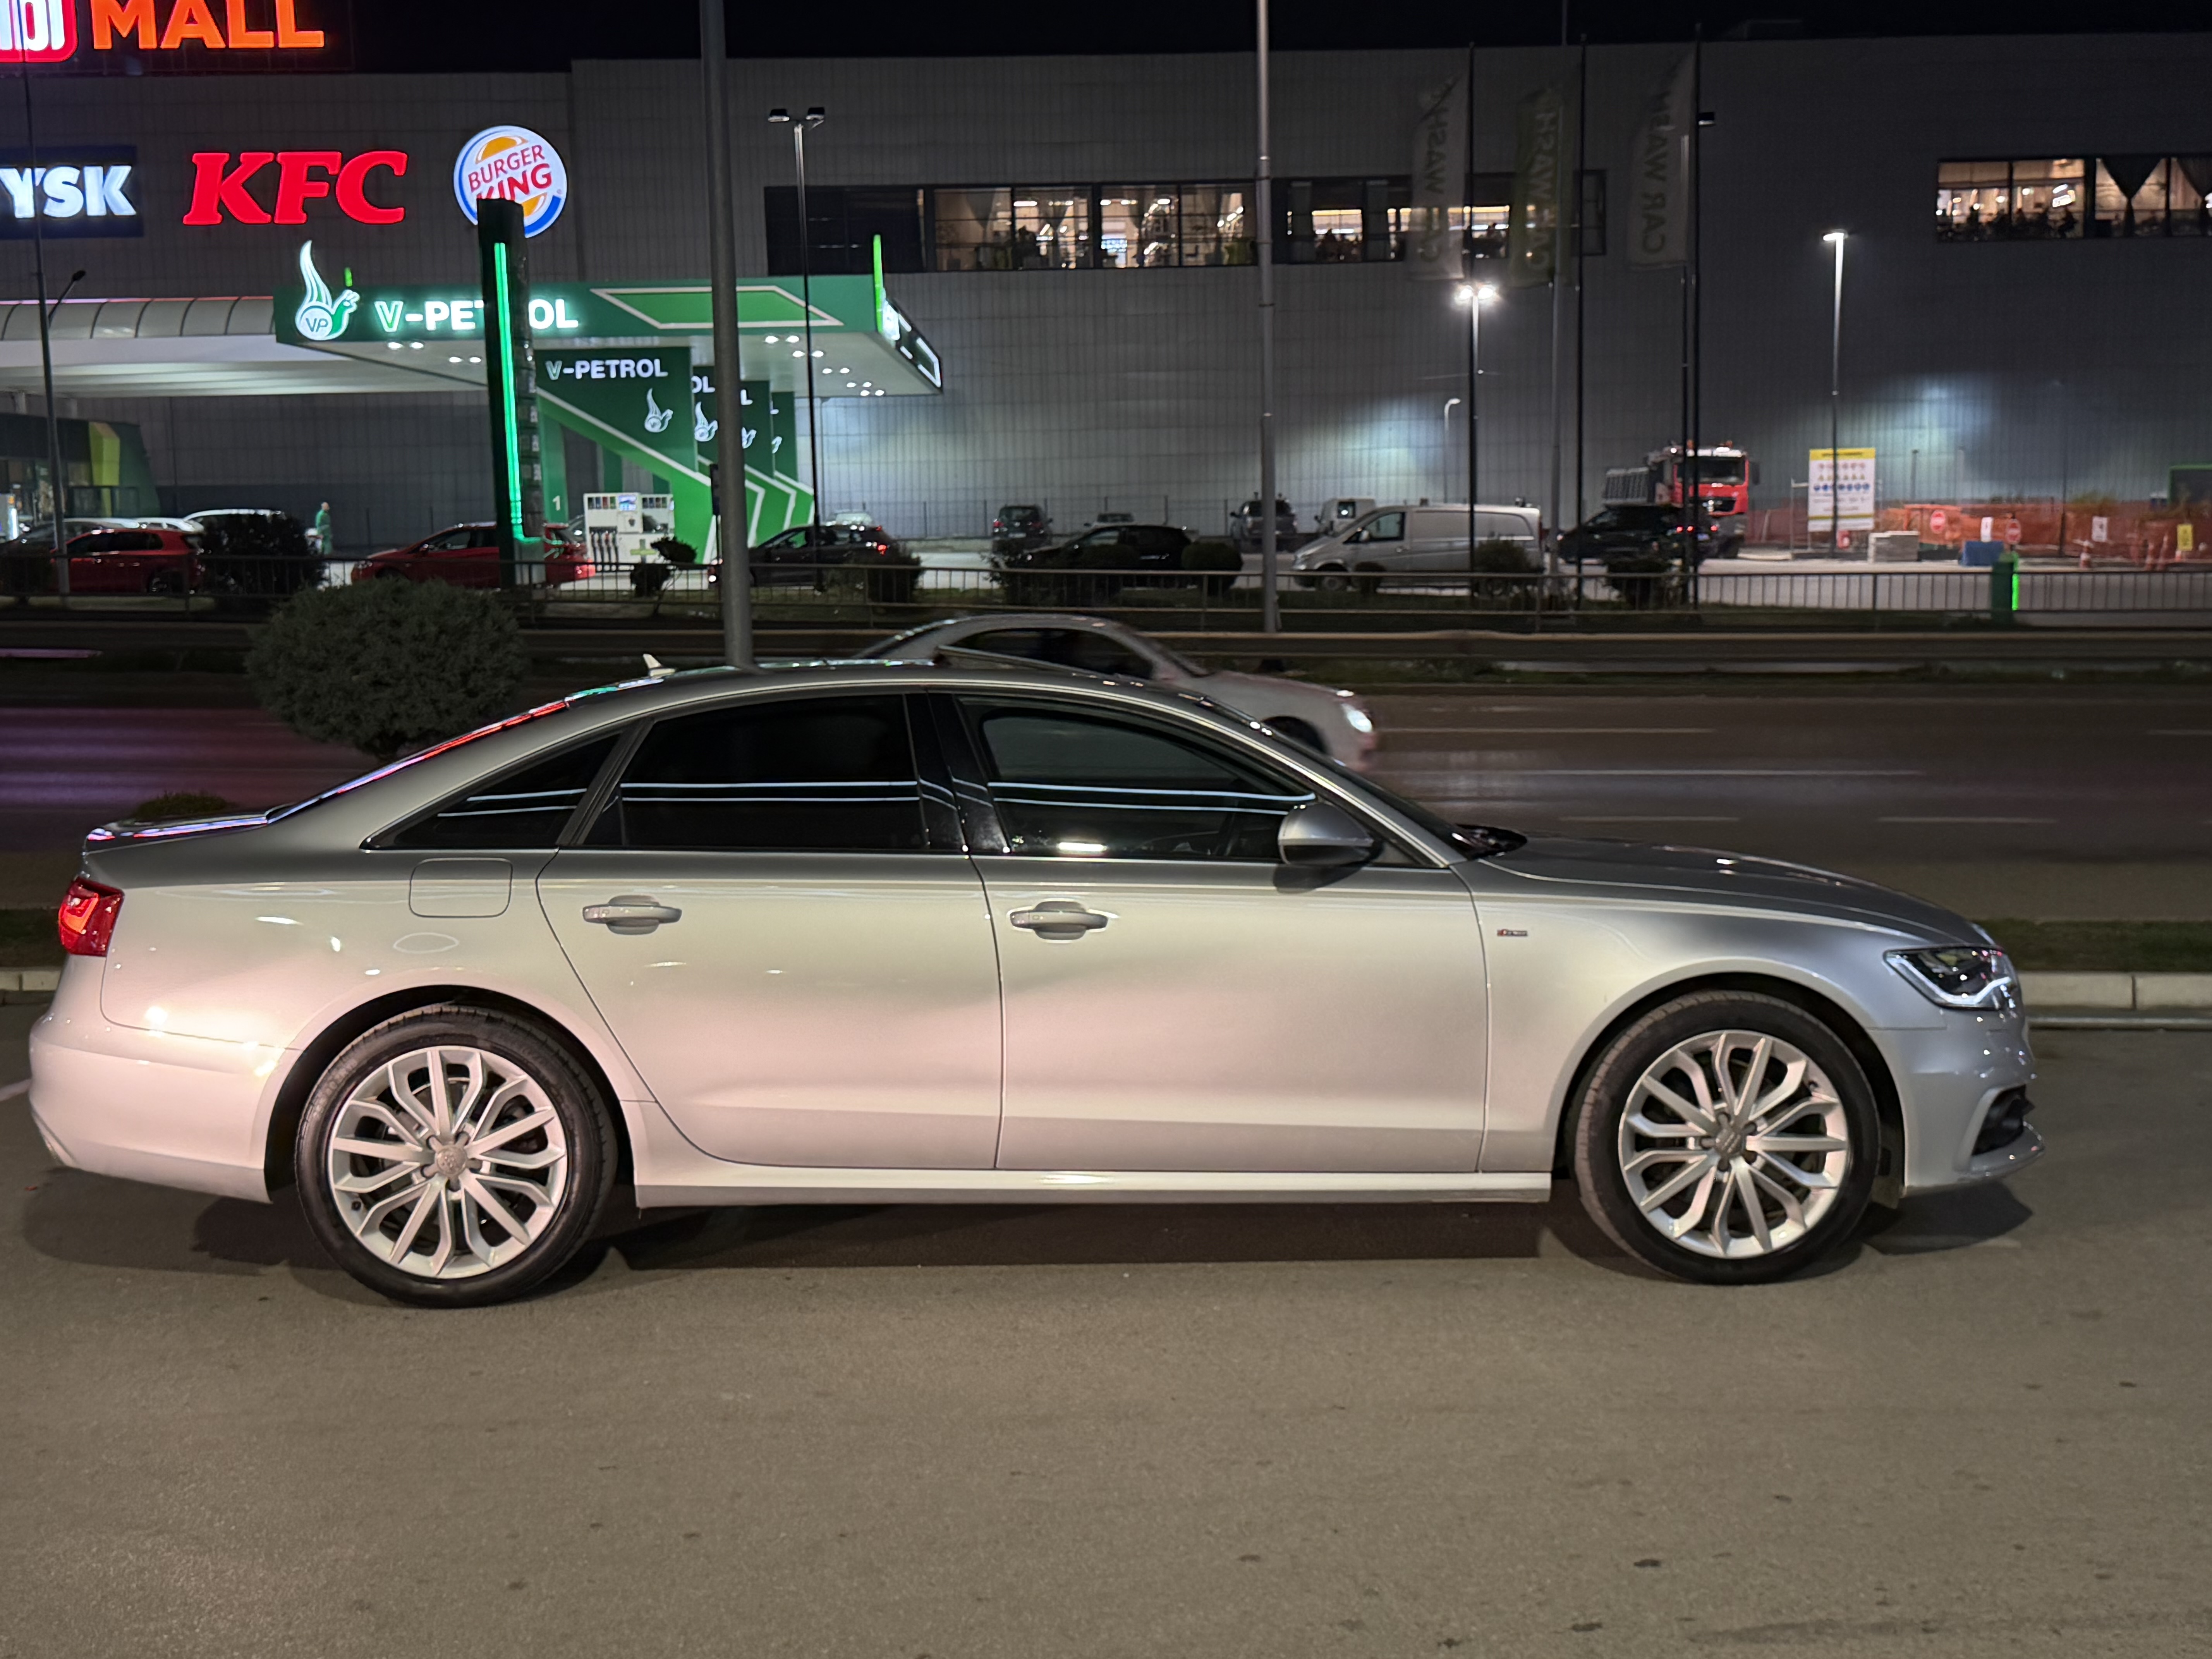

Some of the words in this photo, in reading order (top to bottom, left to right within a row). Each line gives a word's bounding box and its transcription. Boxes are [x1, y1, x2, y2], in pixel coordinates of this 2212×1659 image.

[90, 0, 324, 49] MALL
[468, 144, 545, 193] BURGER
[476, 163, 552, 201] ING
[182, 151, 408, 224] KFC
[306, 318, 329, 333] VP
[374, 299, 579, 332] V-PEOL
[545, 359, 668, 380] V-PETROL
[552, 495, 560, 510] 1
